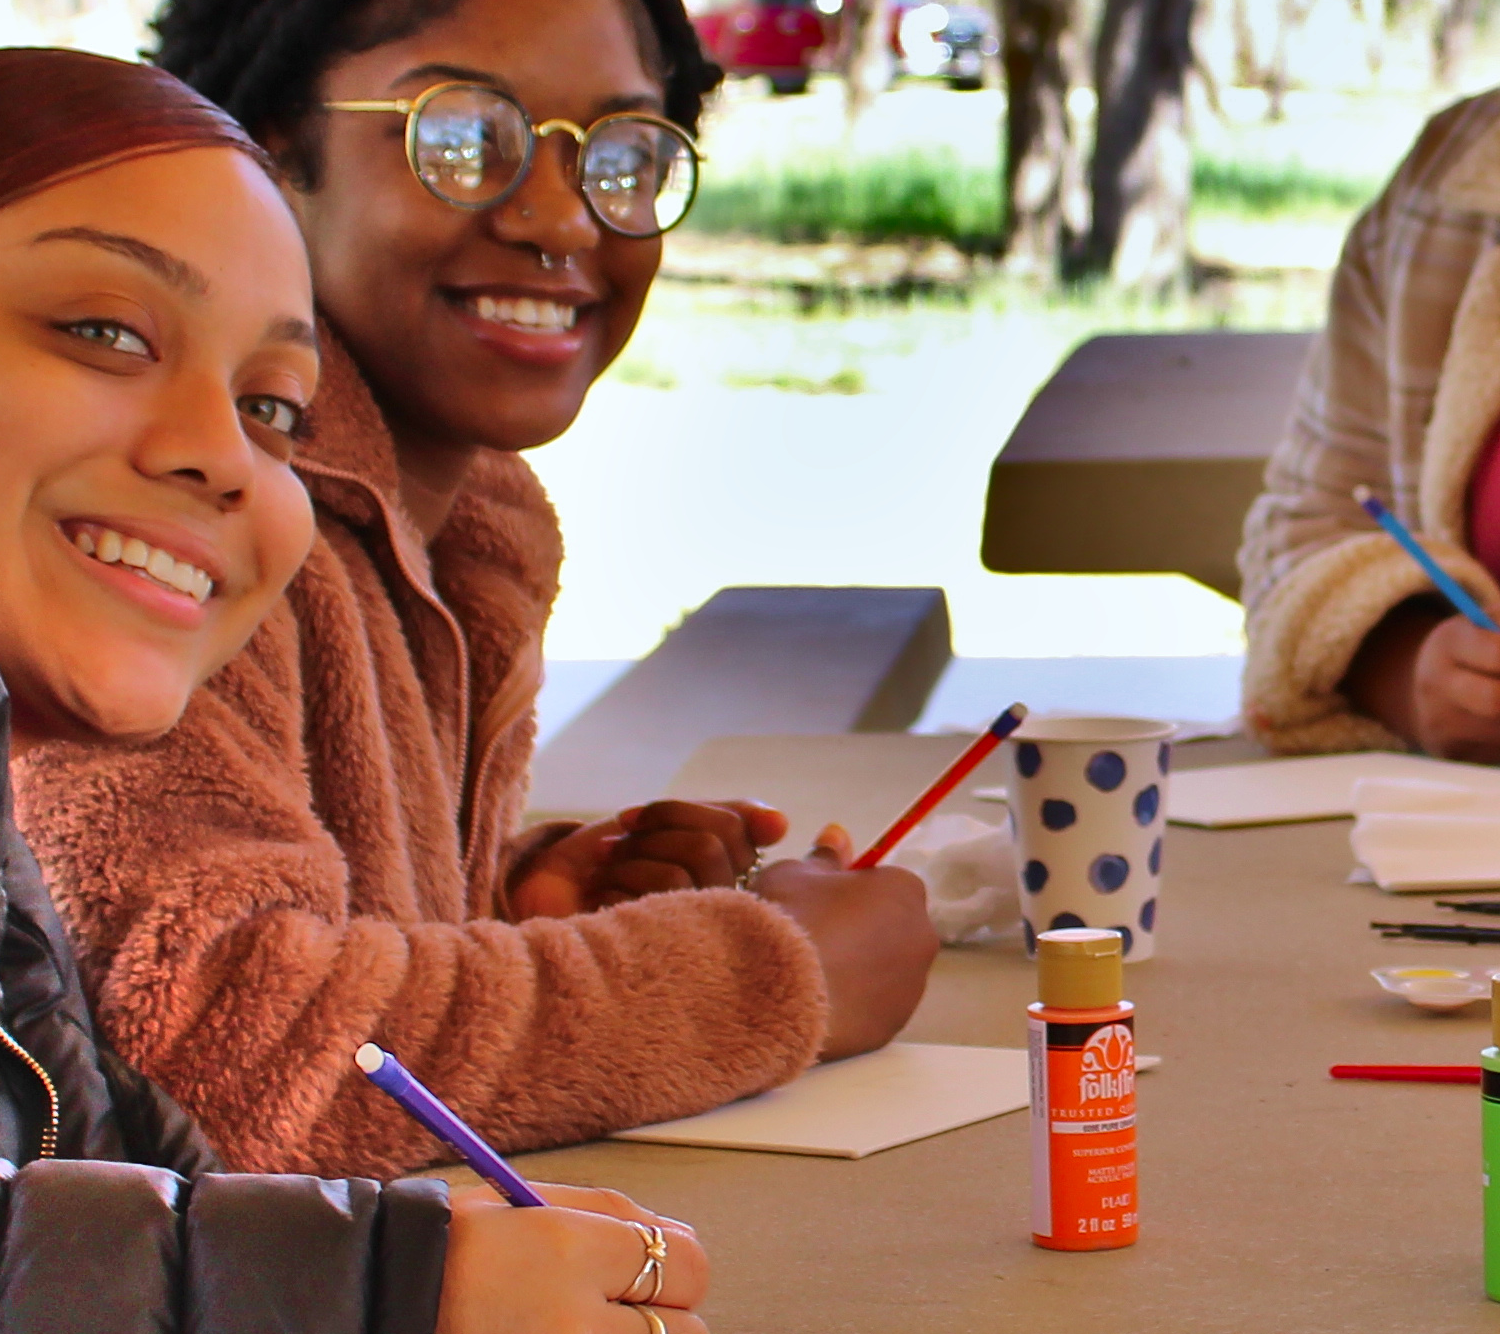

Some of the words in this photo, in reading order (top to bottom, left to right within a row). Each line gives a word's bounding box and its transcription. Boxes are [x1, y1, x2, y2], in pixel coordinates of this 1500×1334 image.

[1051, 1107, 1114, 1118] TRUSTED
[1078, 1218, 1087, 1234] 2
[1102, 1218, 1117, 1232] oz
